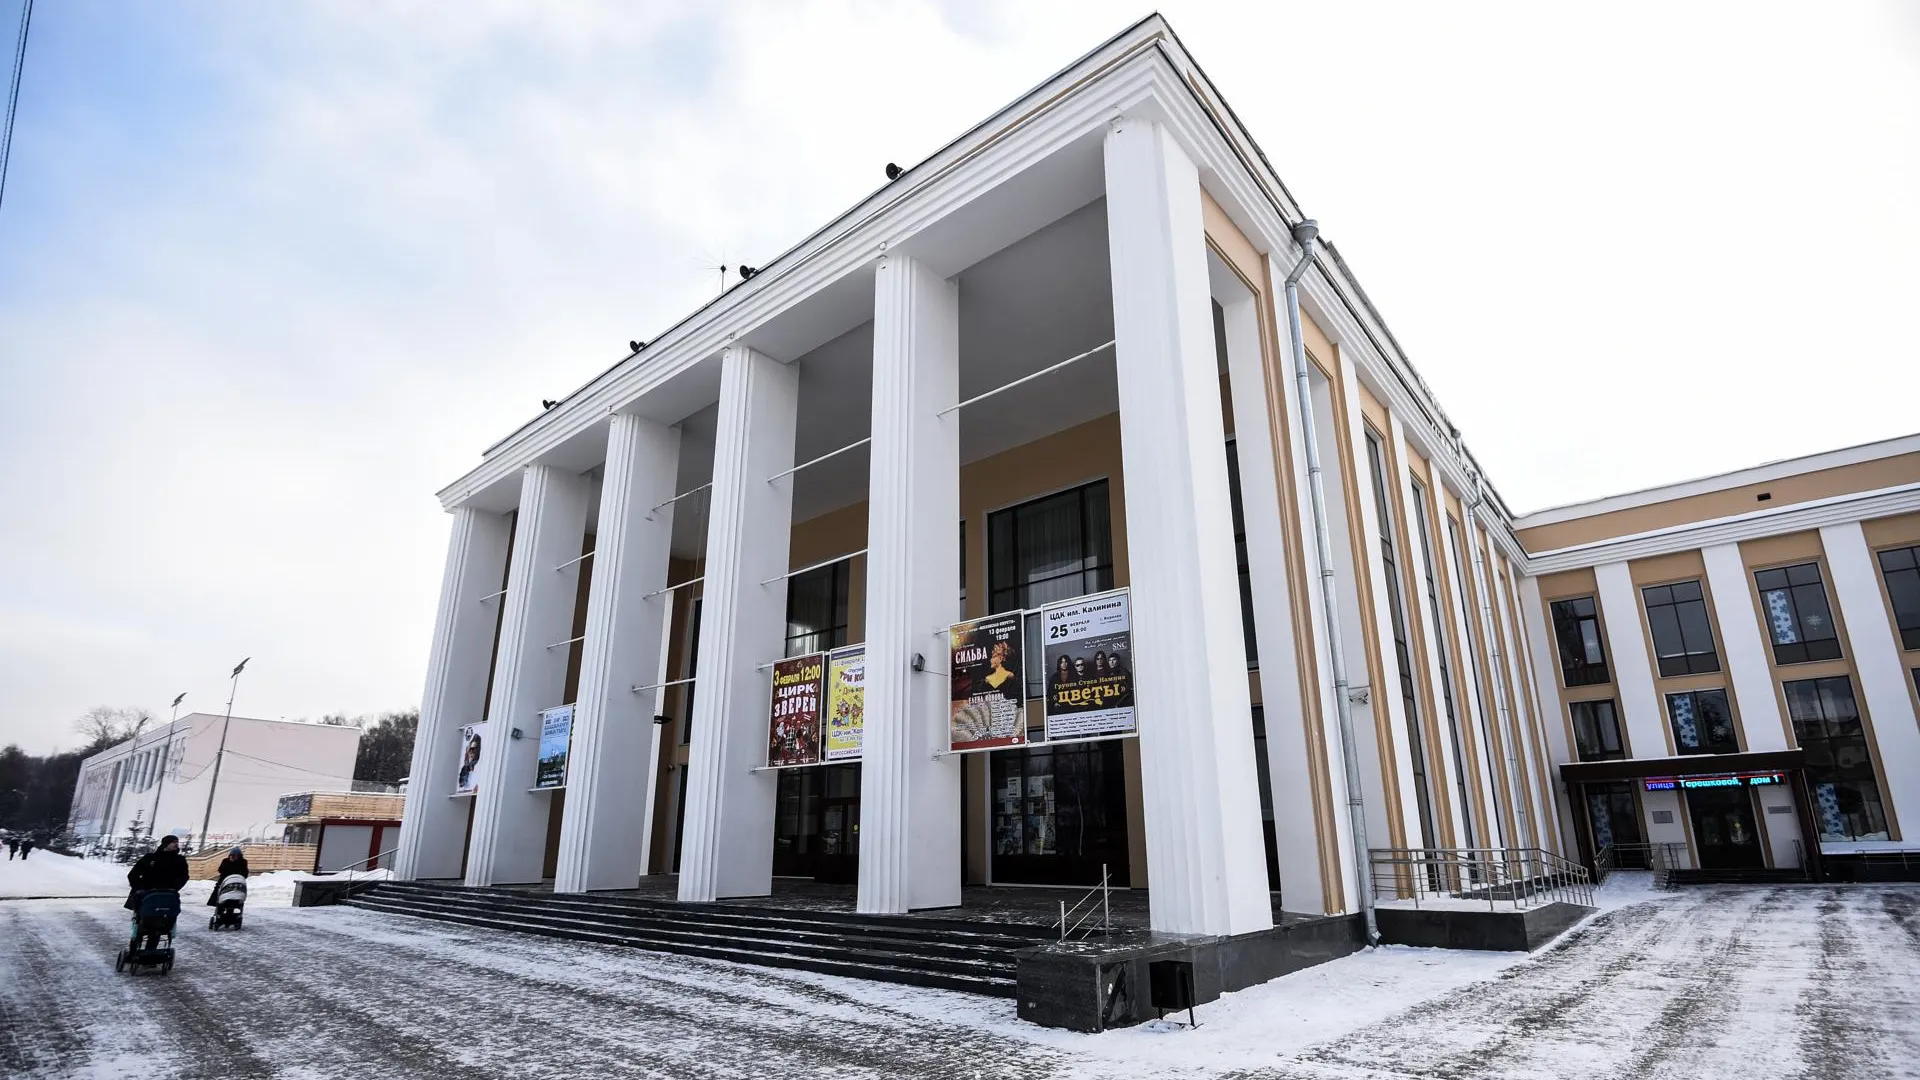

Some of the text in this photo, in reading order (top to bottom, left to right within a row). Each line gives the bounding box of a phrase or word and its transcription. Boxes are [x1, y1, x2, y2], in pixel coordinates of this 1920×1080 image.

[1050, 611, 1065, 621] ЦДК
[1082, 601, 1122, 614] Калинина
[1050, 624, 1069, 639] 25
[1112, 641, 1127, 650] SNC
[955, 646, 988, 664] СИЛЬВА
[774, 664, 821, 686] 3 ФЕВРАЛЯ 12:00
[1054, 682, 1077, 690] Группа
[1099, 675, 1126, 683] Намина
[778, 683, 815, 698] ЦИРК
[774, 693, 816, 717] ЗВЕРЕЙ
[1646, 774, 1779, 790] улица Терешковой, дом 1
